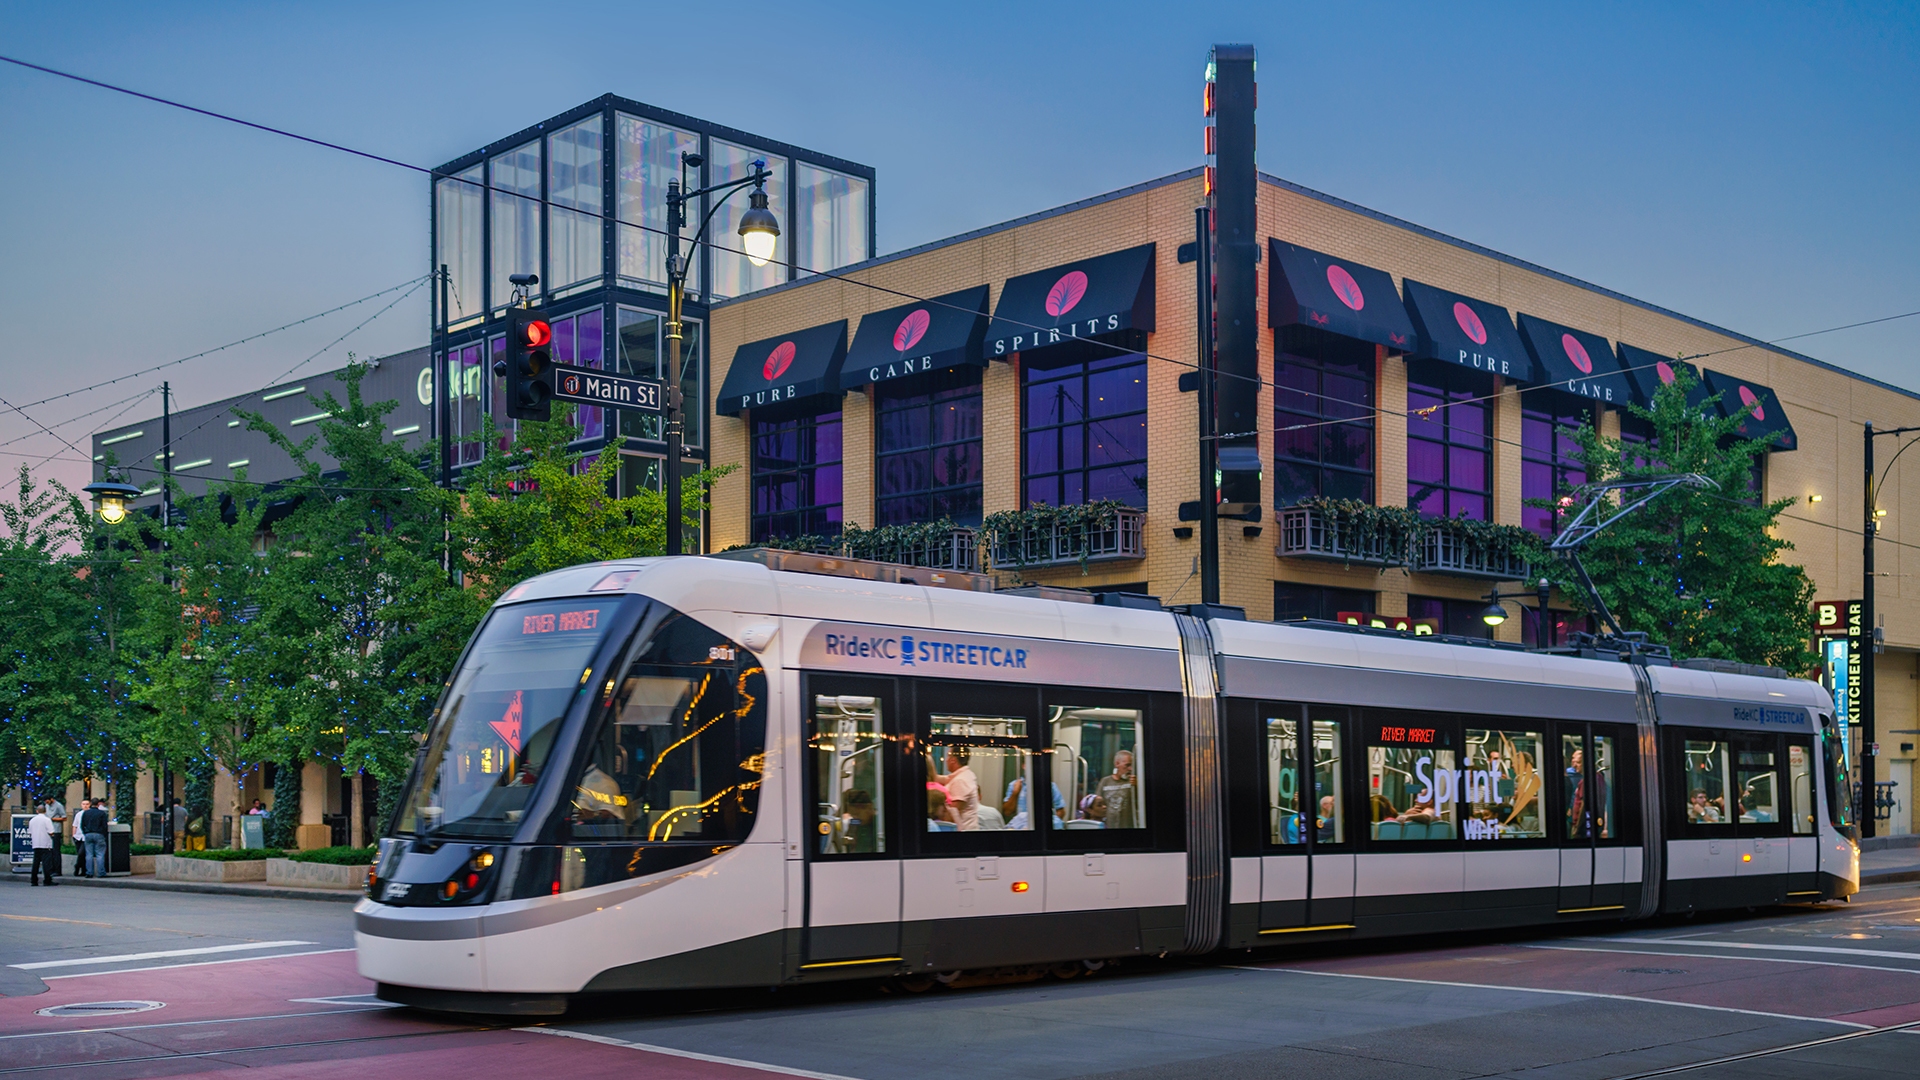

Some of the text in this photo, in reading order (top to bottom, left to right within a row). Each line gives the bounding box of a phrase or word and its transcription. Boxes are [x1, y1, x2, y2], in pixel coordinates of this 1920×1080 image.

[994, 314, 1119, 355] SPIRITS
[869, 355, 932, 382] CANE
[1458, 349, 1510, 375] PURE
[586, 377, 656, 406] Main St
[741, 384, 796, 408] PURE
[1568, 378, 1613, 402] CANE
[522, 609, 600, 635] RIVER MARKET
[1849, 604, 1861, 636] BAR
[709, 646, 735, 661] 801
[825, 633, 1028, 669] RideKC STREETCAR
[1849, 653, 1861, 723] KITCHEN
[1733, 707, 1806, 725] RideKC STREETCAR
[1381, 726, 1436, 743] RIVER MARKET
[1415, 755, 1504, 817] Sprint
[1462, 817, 1500, 841] Wi-Fi
